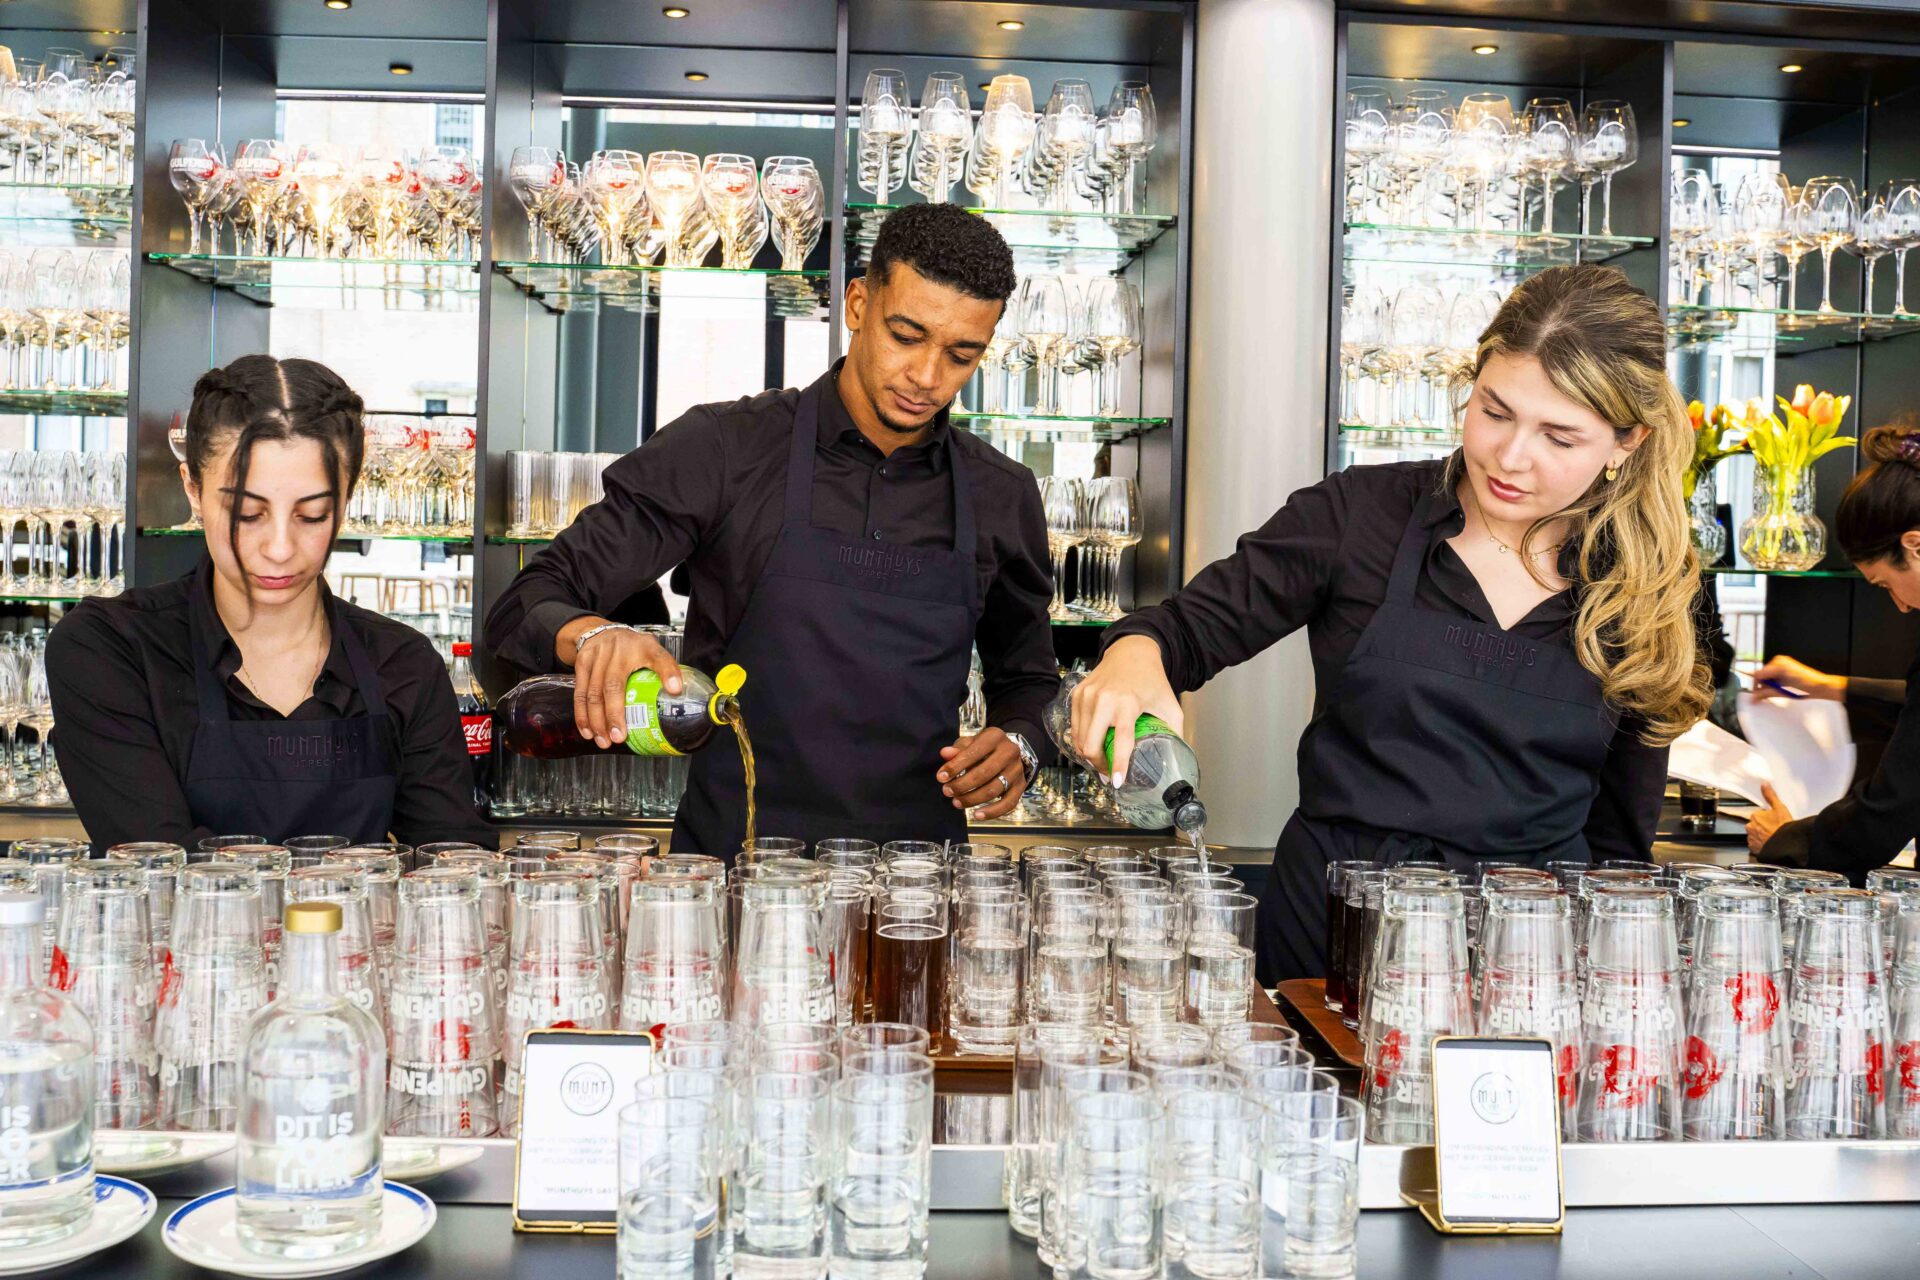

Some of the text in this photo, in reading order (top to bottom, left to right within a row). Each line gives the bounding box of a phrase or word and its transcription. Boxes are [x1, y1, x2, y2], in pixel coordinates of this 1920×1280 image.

[838, 545, 922, 576] MUNTHUYS
[1444, 625, 1537, 666] MUNTHUYS
[267, 733, 361, 757] MUNTHUYS
[506, 992, 606, 1021] GULPENER
[622, 993, 722, 1024] GULPENER
[568, 1080, 608, 1094] MUNT
[1, 1104, 32, 1128] IS
[275, 1111, 354, 1138] DIT IS
